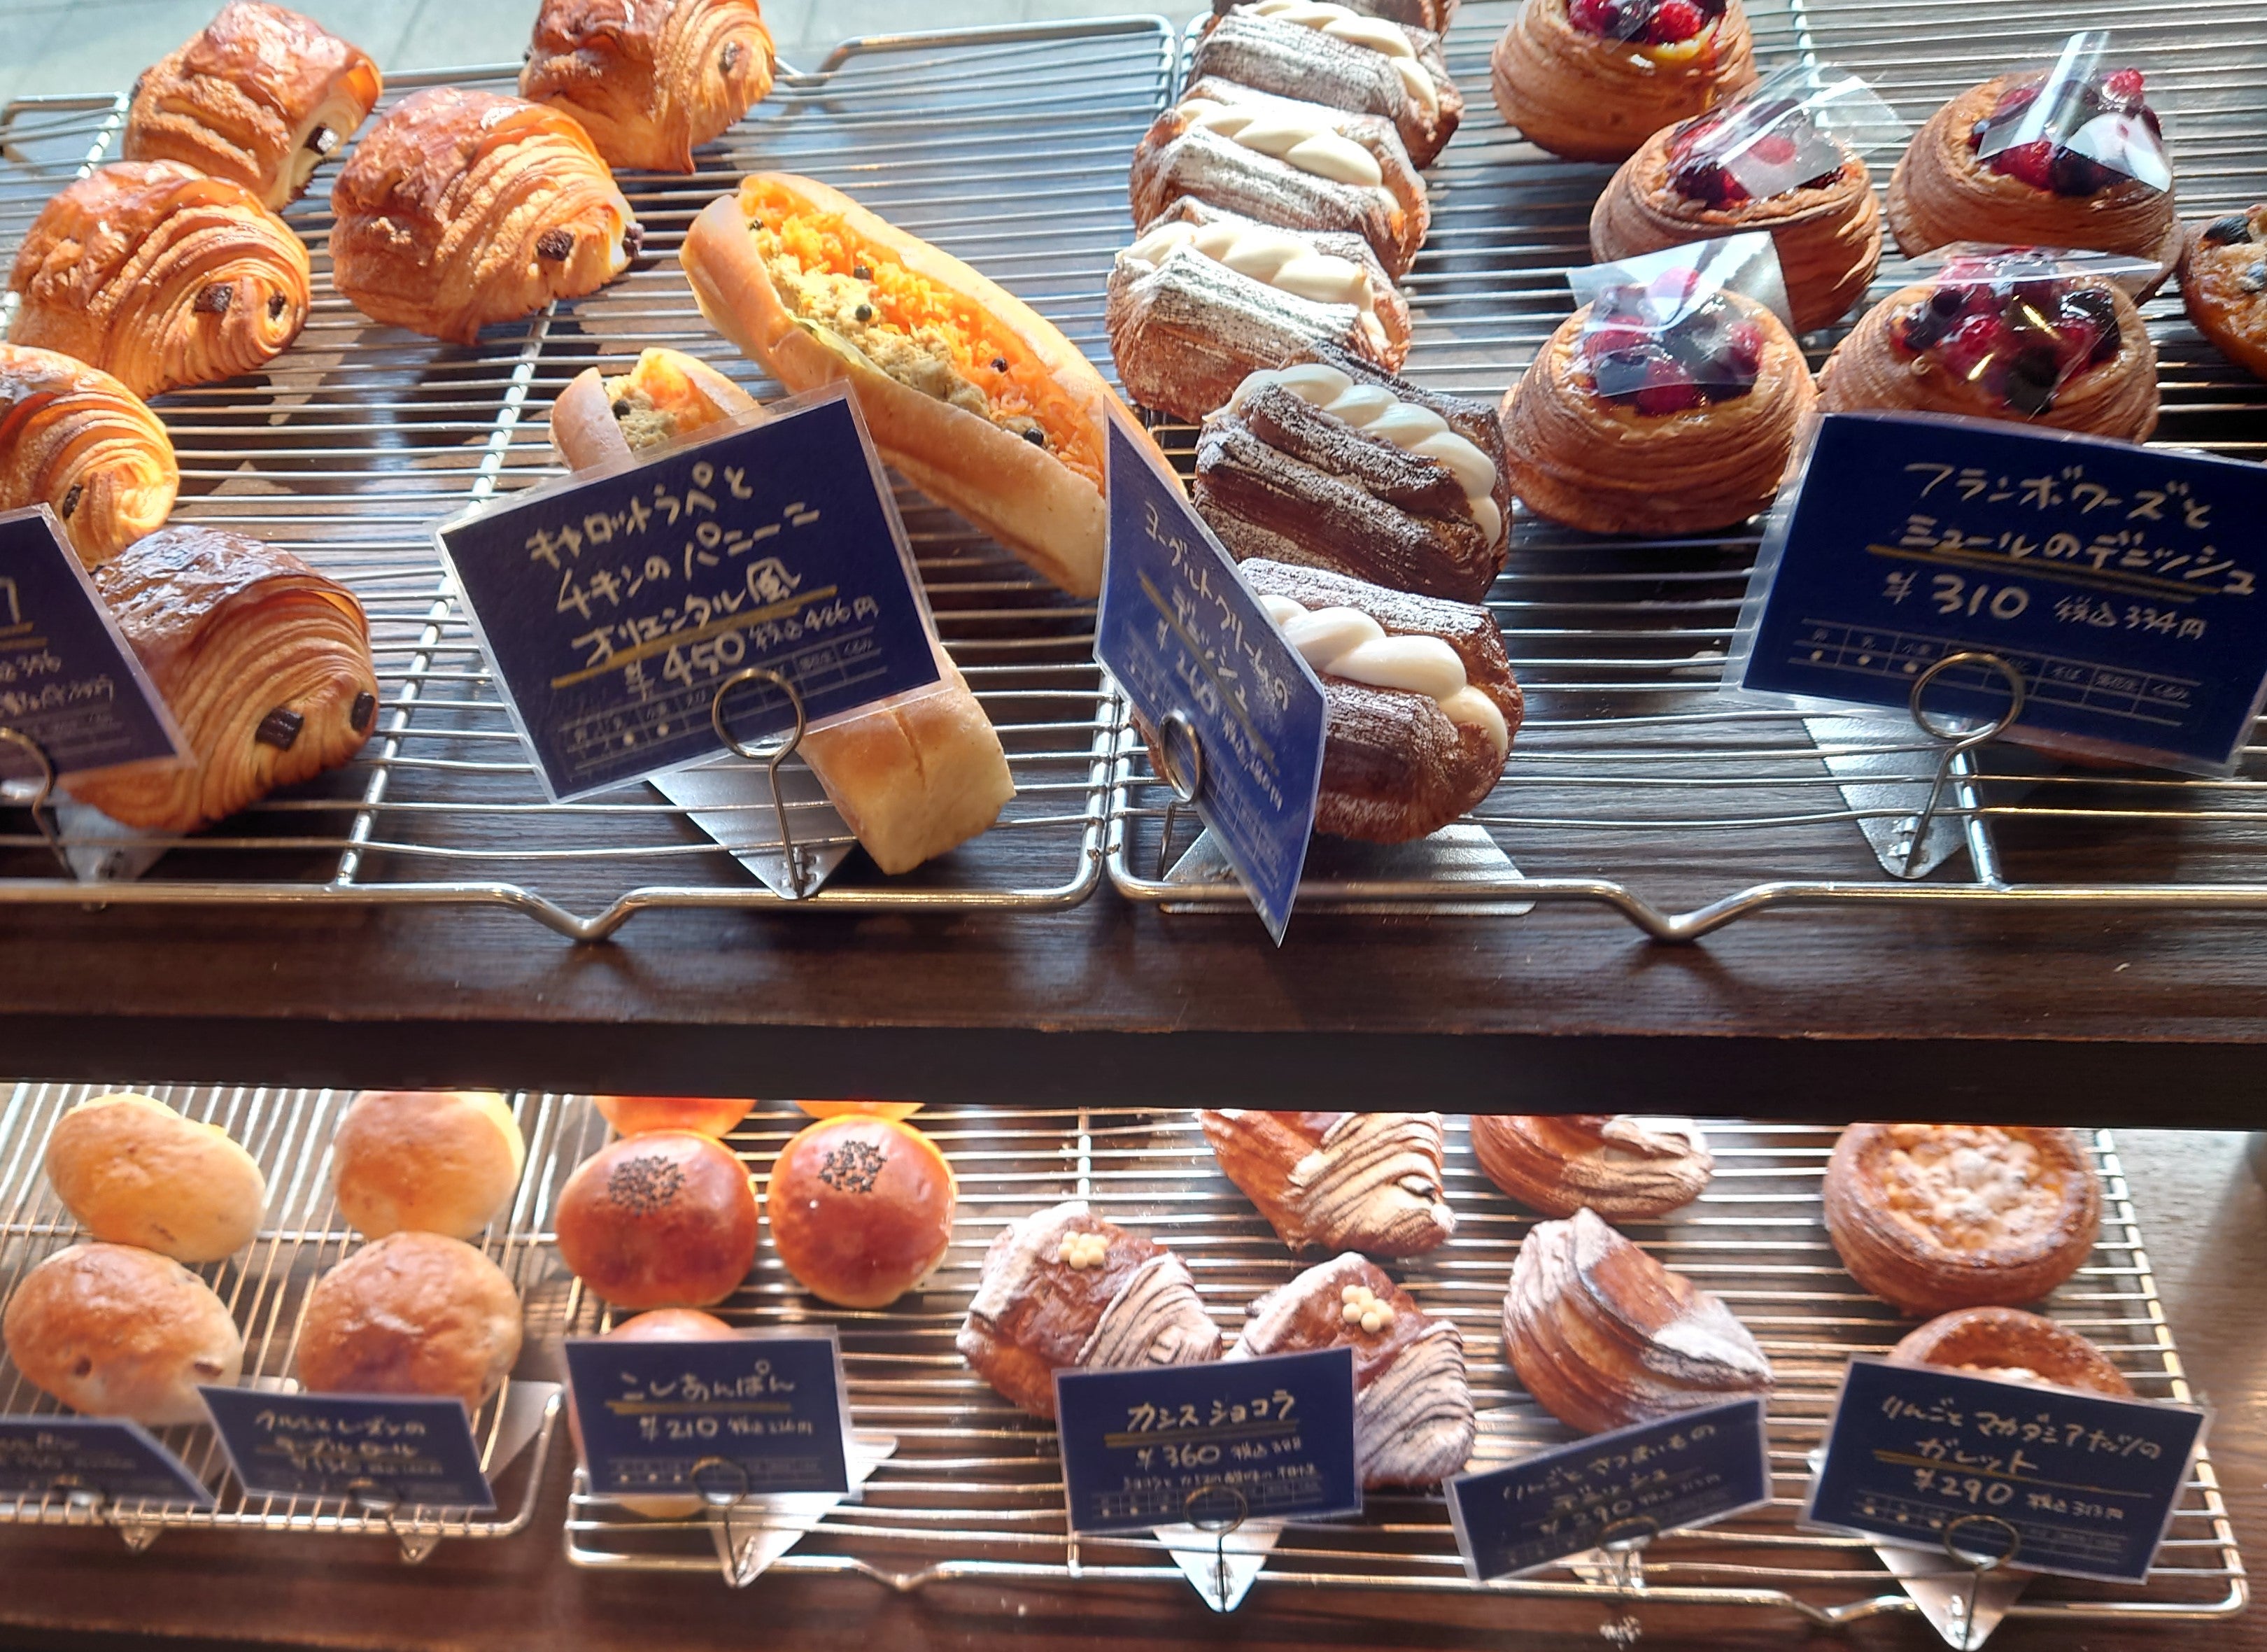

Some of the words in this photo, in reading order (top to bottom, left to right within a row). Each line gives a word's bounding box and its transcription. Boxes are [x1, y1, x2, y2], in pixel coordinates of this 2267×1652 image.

[1905, 463, 2211, 529] フランボワーズと
[556, 501, 820, 619] チキンのパニーニ
[1898, 514, 2255, 595] ミュールのデニッシュ
[570, 558, 802, 666] オリエンタル風
[621, 1359, 795, 1402] こしあんぱん
[1914, 1468, 2014, 1504] ¥290
[1916, 1438, 2038, 1475] ガレット
